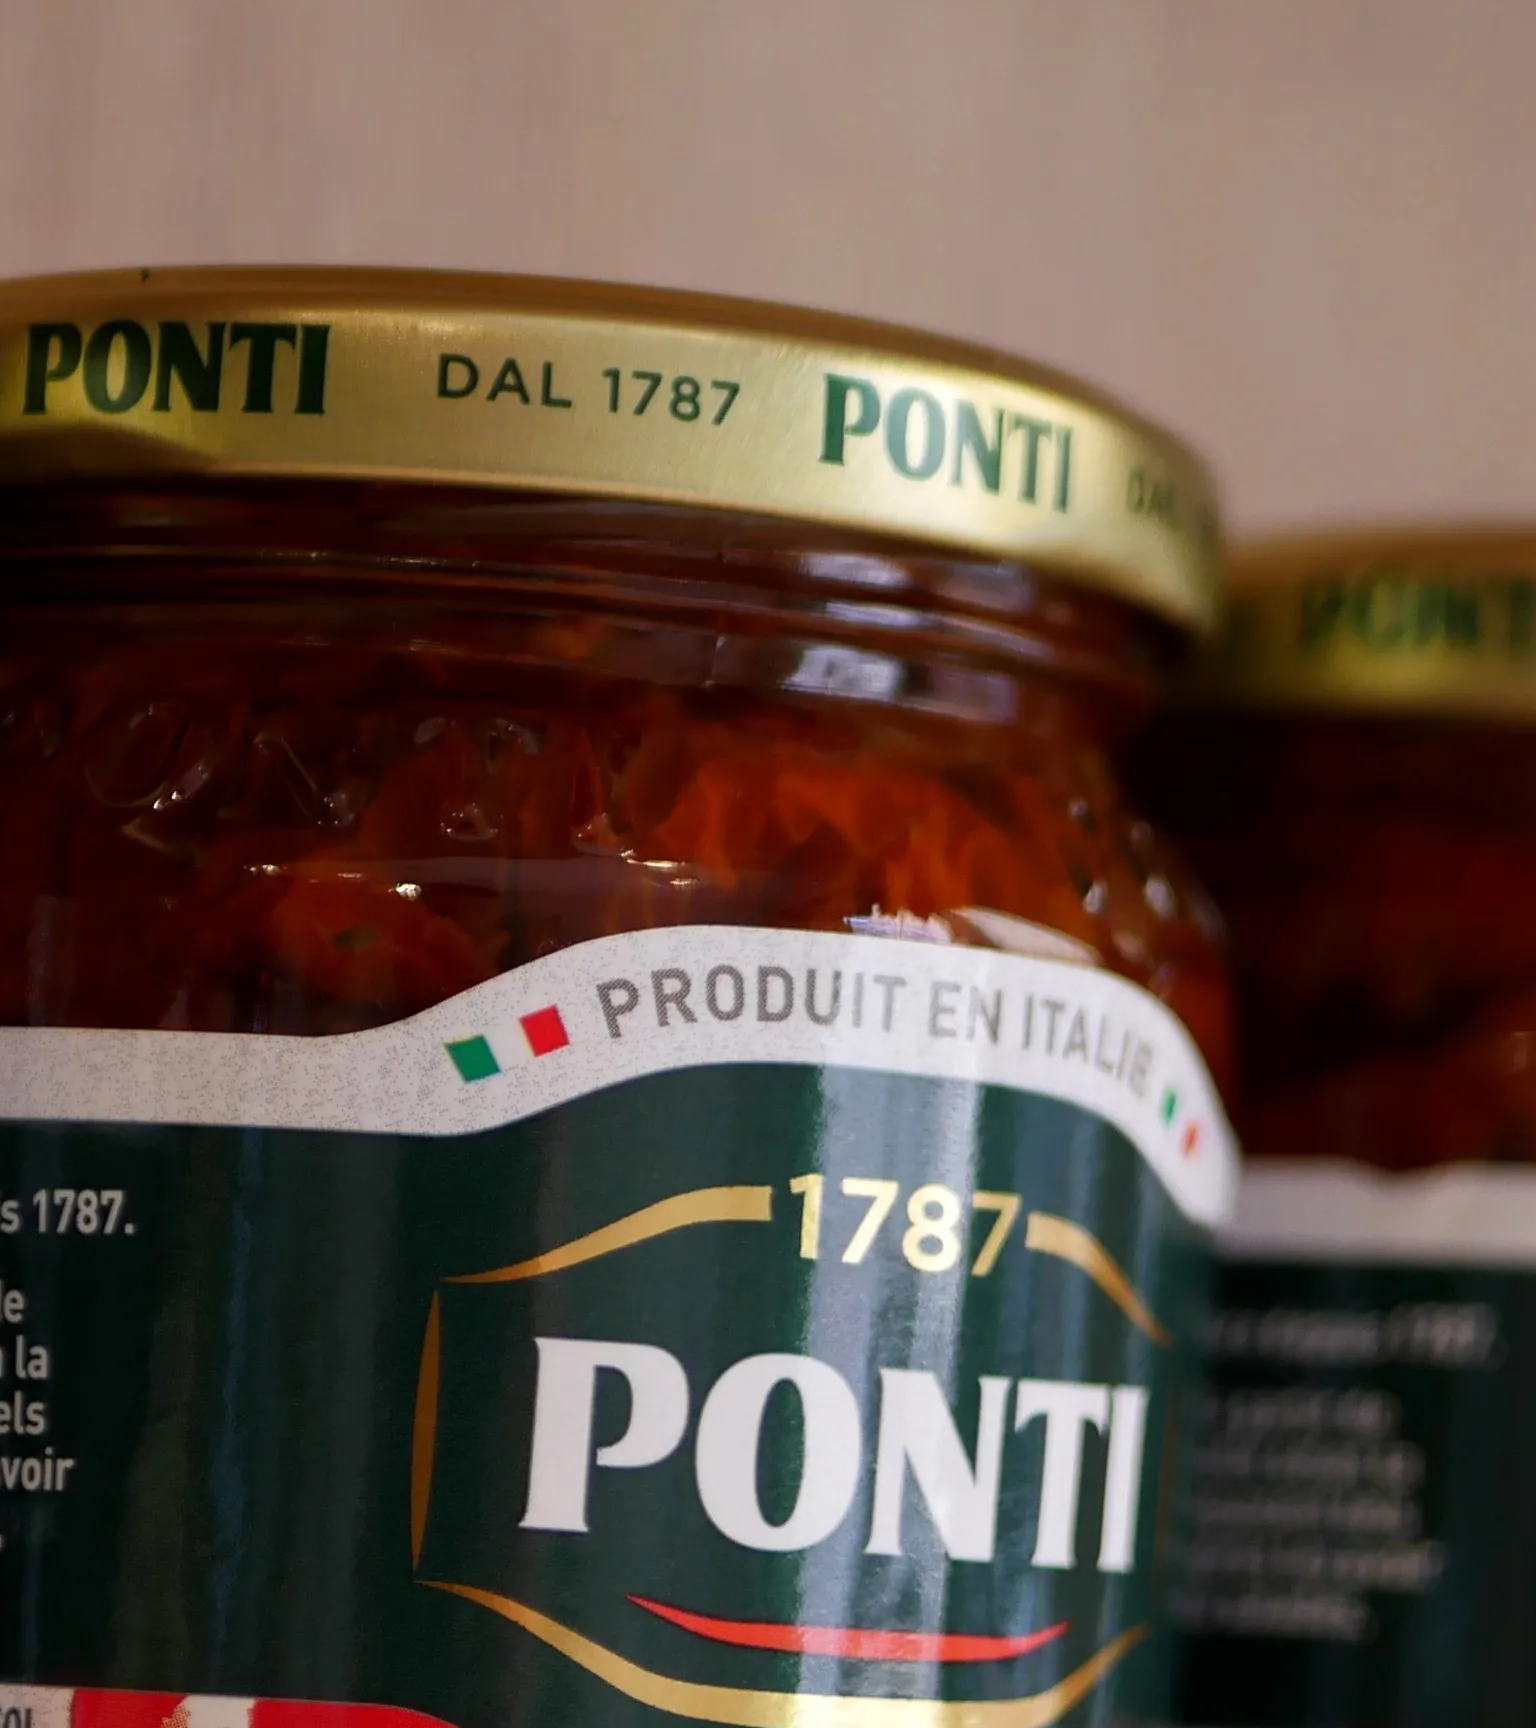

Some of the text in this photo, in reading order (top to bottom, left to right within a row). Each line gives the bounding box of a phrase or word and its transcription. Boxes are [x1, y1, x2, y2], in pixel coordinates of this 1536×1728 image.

[21, 320, 331, 416] PONTI
[436, 352, 573, 411] DAL
[601, 366, 741, 427] 1787
[818, 373, 1076, 513] PONTI
[596, 964, 1156, 1100] PRODUIT EN ITALIE
[32, 1188, 137, 1235] 1787.
[789, 1172, 1023, 1277] 1787
[15, 1334, 50, 1380] la
[517, 1336, 1150, 1575] PONTI
